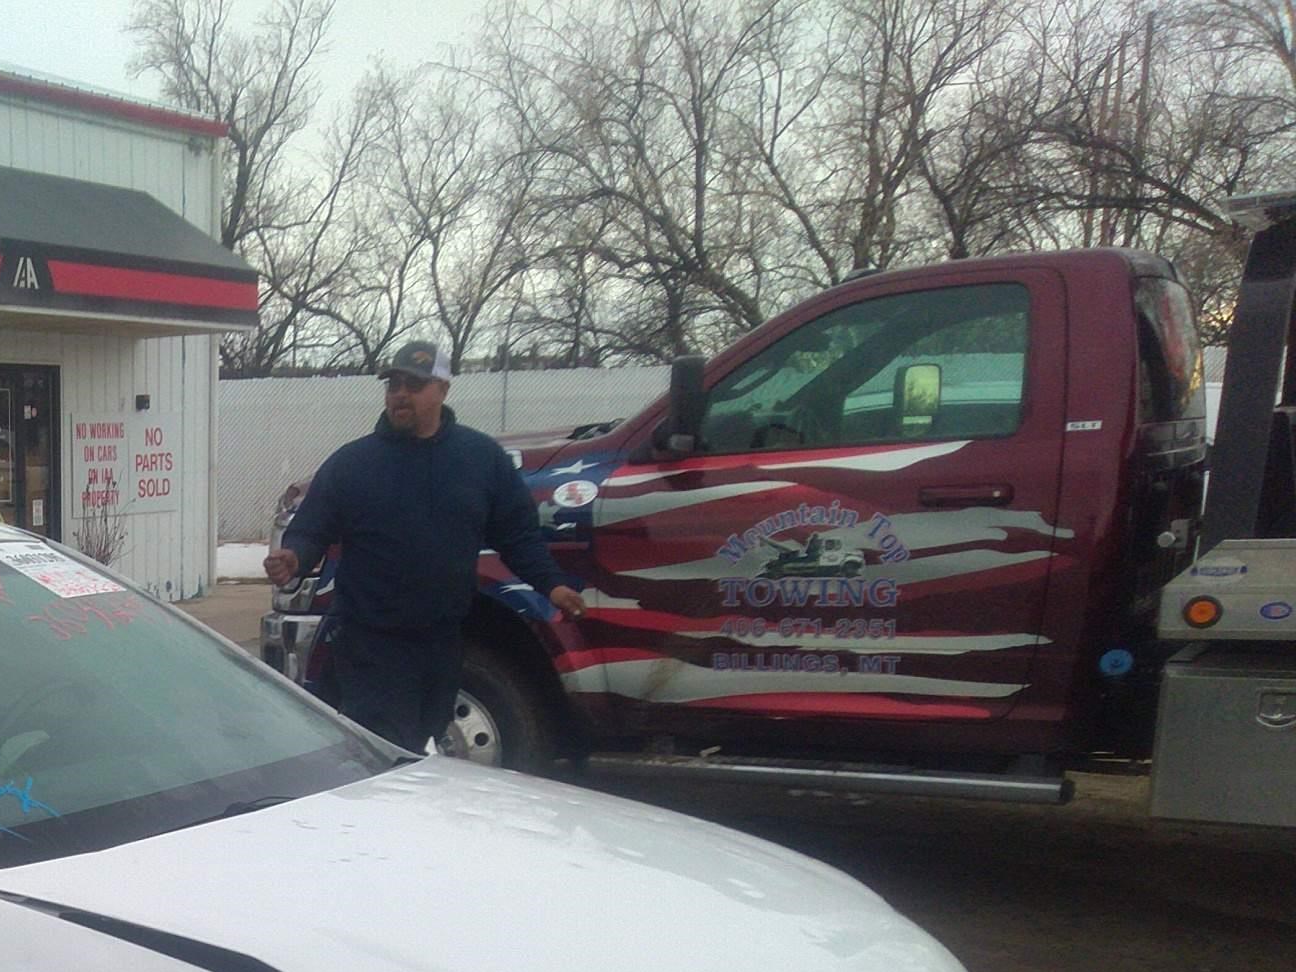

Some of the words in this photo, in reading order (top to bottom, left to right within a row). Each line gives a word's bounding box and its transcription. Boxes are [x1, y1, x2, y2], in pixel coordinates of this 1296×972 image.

[75, 423, 87, 440] NO
[89, 422, 124, 439] WORKING
[145, 427, 163, 447] NO
[84, 445, 95, 462] ON
[97, 445, 117, 462] CARS
[135, 452, 173, 472] PARTS
[88, 468, 98, 485] ON
[138, 478, 171, 498] SOLD
[81, 489, 119, 508] PROPERTY
[716, 500, 860, 565] Mountain
[865, 511, 911, 564] Top
[718, 576, 902, 608] TOWING
[858, 654, 902, 675] MT
